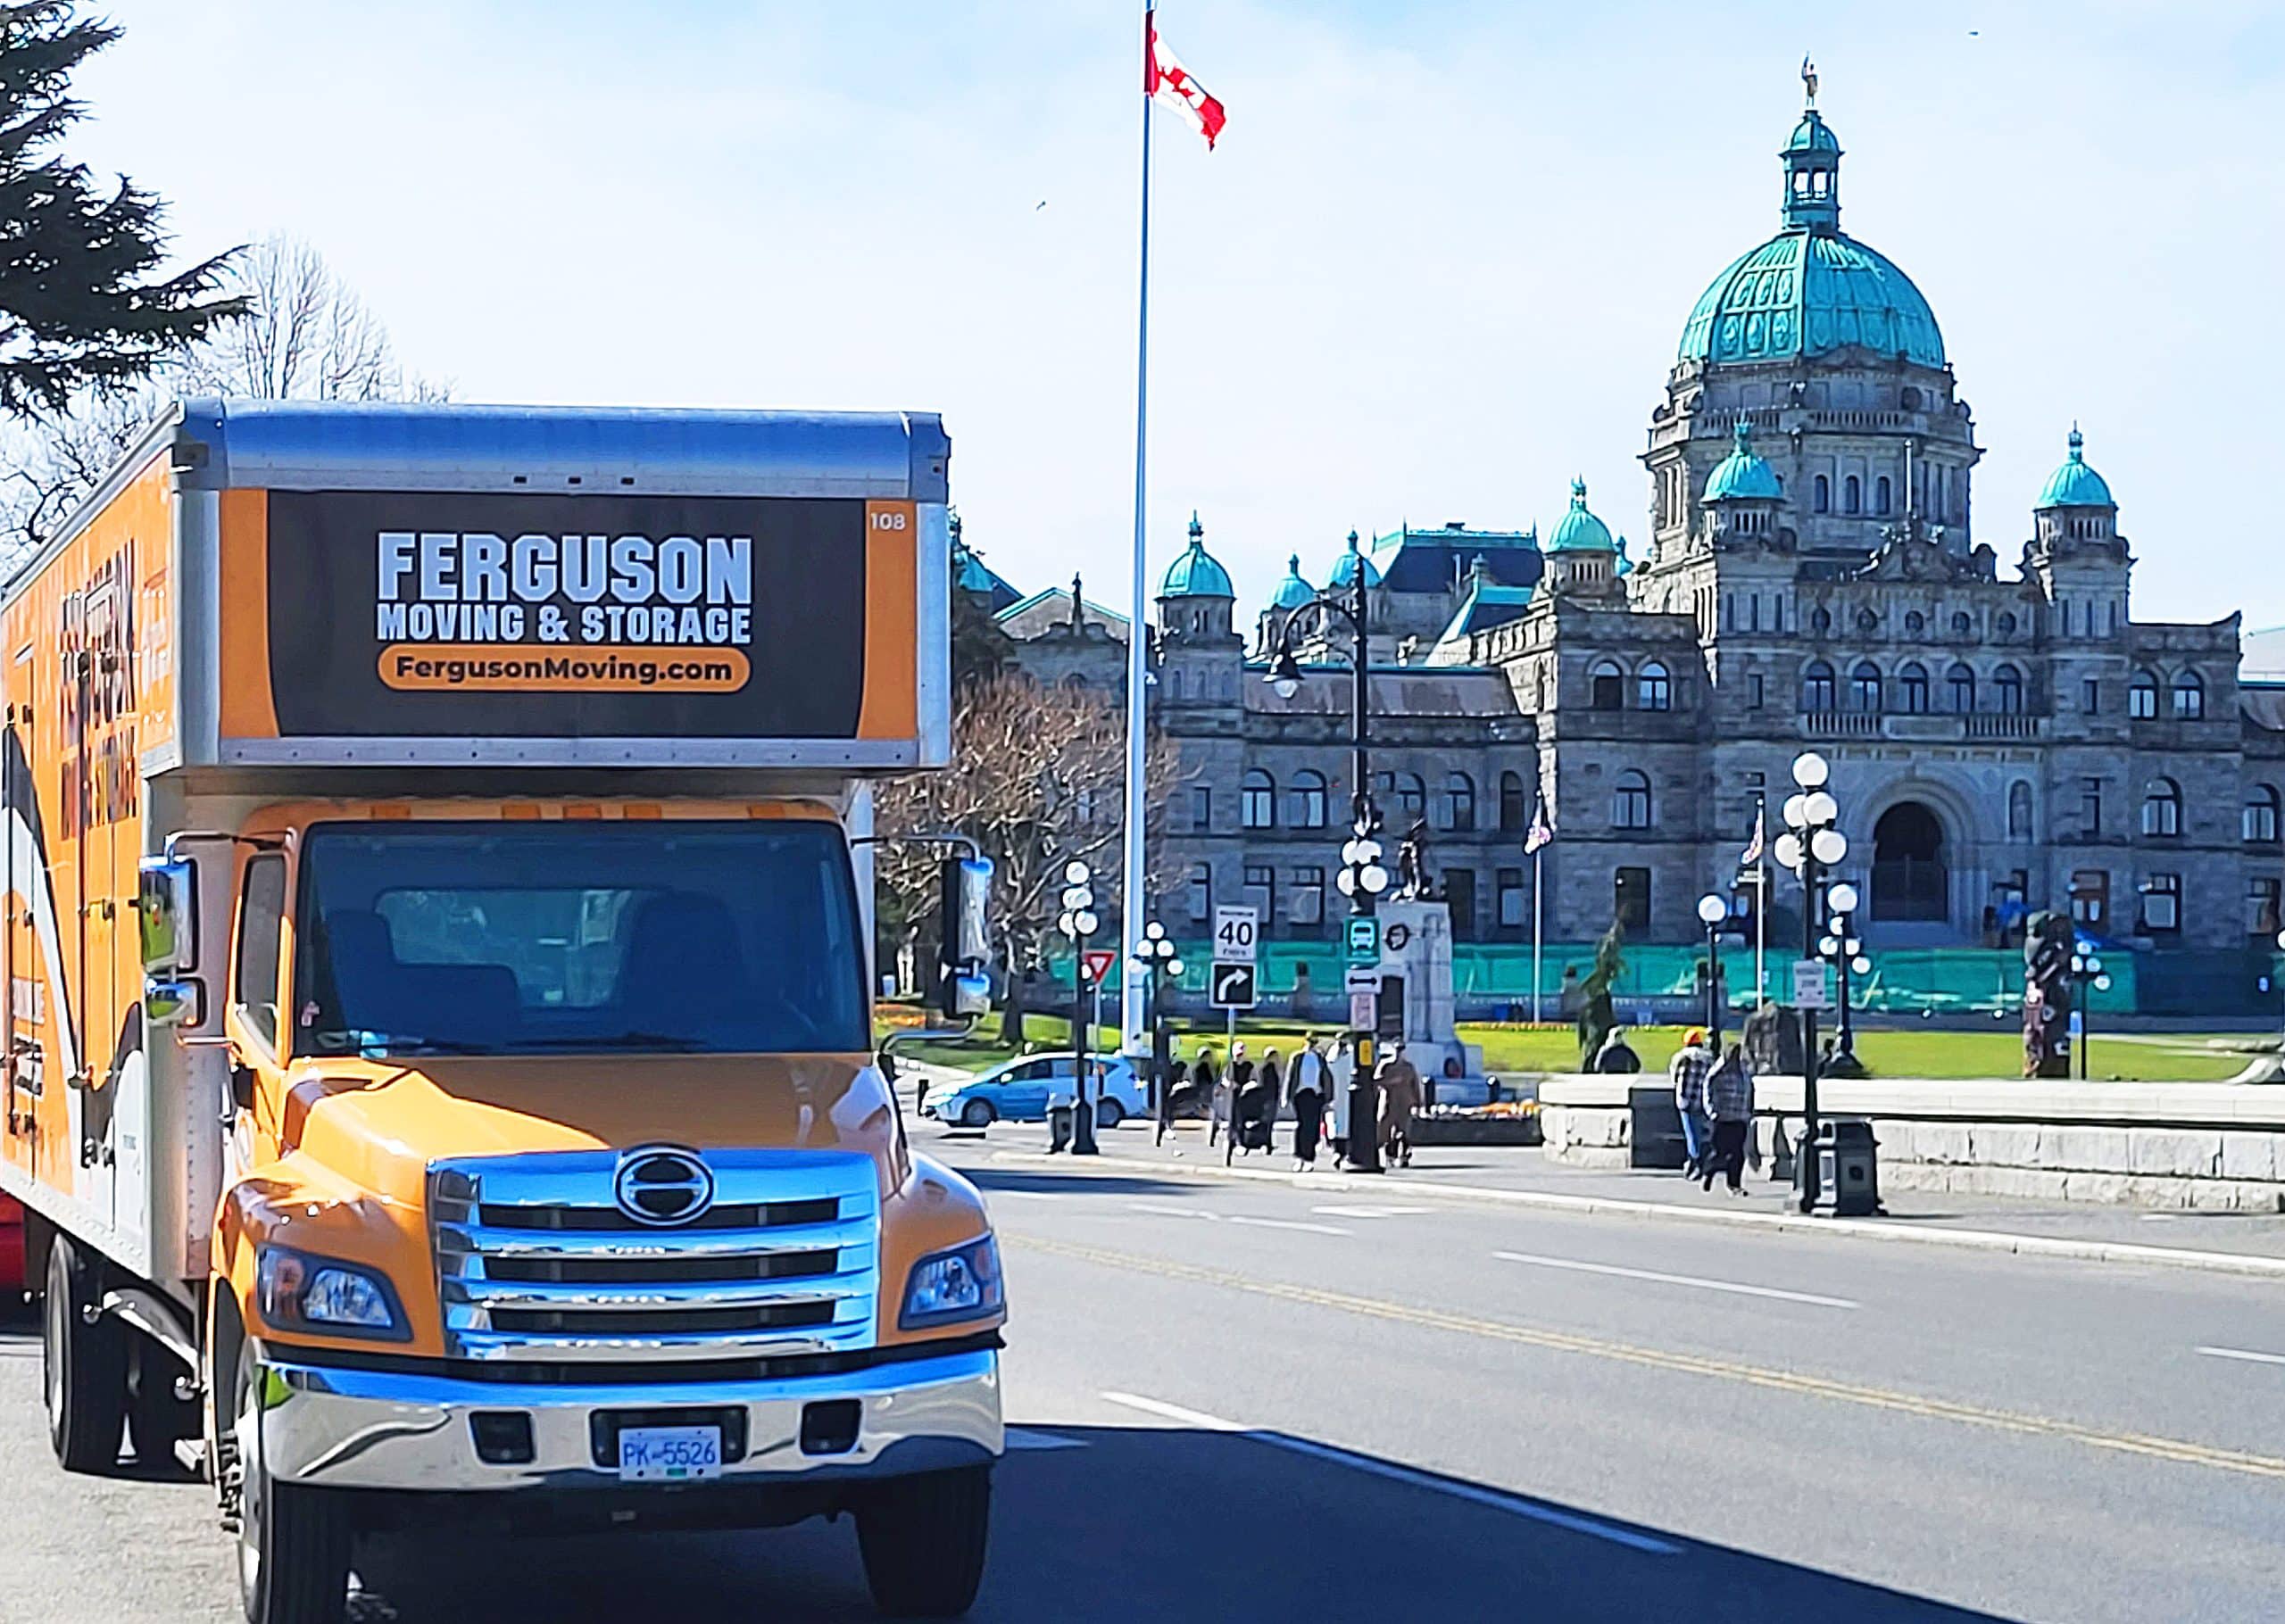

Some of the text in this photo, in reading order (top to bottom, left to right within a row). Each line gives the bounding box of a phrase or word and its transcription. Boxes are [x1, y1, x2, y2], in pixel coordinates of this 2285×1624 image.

[871, 512, 905, 530] 108
[378, 532, 752, 605] FERGUSON
[377, 602, 751, 643] MOVING & STORAGE
[396, 654, 732, 685] FergusonMoving.com
[1218, 920, 1253, 947] 40
